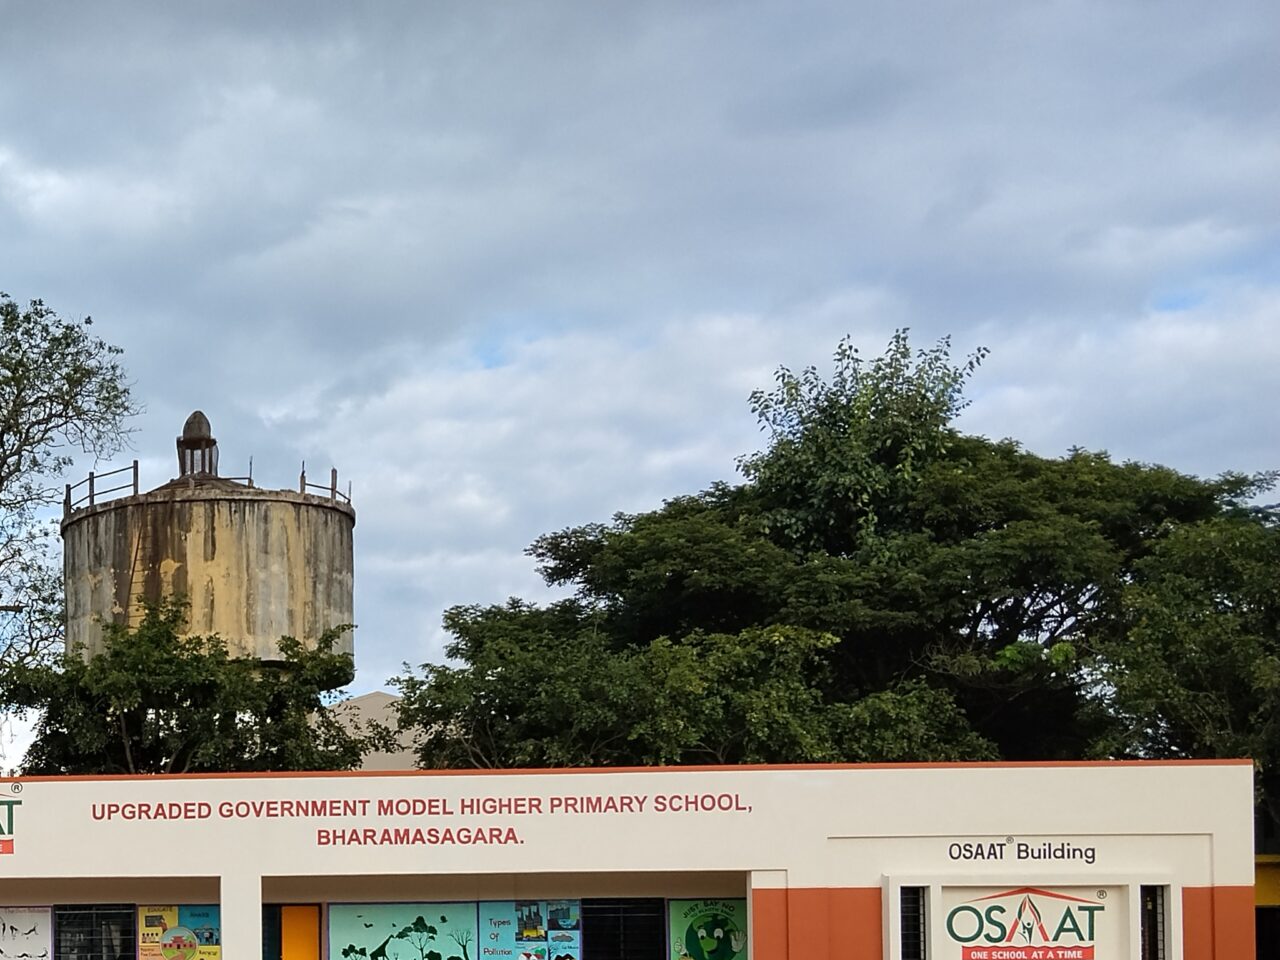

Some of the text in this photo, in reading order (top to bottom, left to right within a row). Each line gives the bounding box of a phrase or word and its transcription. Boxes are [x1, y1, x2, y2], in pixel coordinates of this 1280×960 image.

[92, 793, 753, 820] UPGRADED GOVERNMENT MODEL HIGHER PRIMARY SCHOOL,
[317, 828, 524, 846] BHARAMASAGARA.
[1017, 843, 1096, 864] Building
[722, 902, 735, 912] NO
[489, 918, 511, 928] Types
[483, 947, 512, 955] Pollution
[971, 950, 1083, 959] ONE SCHOOL AT A TIME
